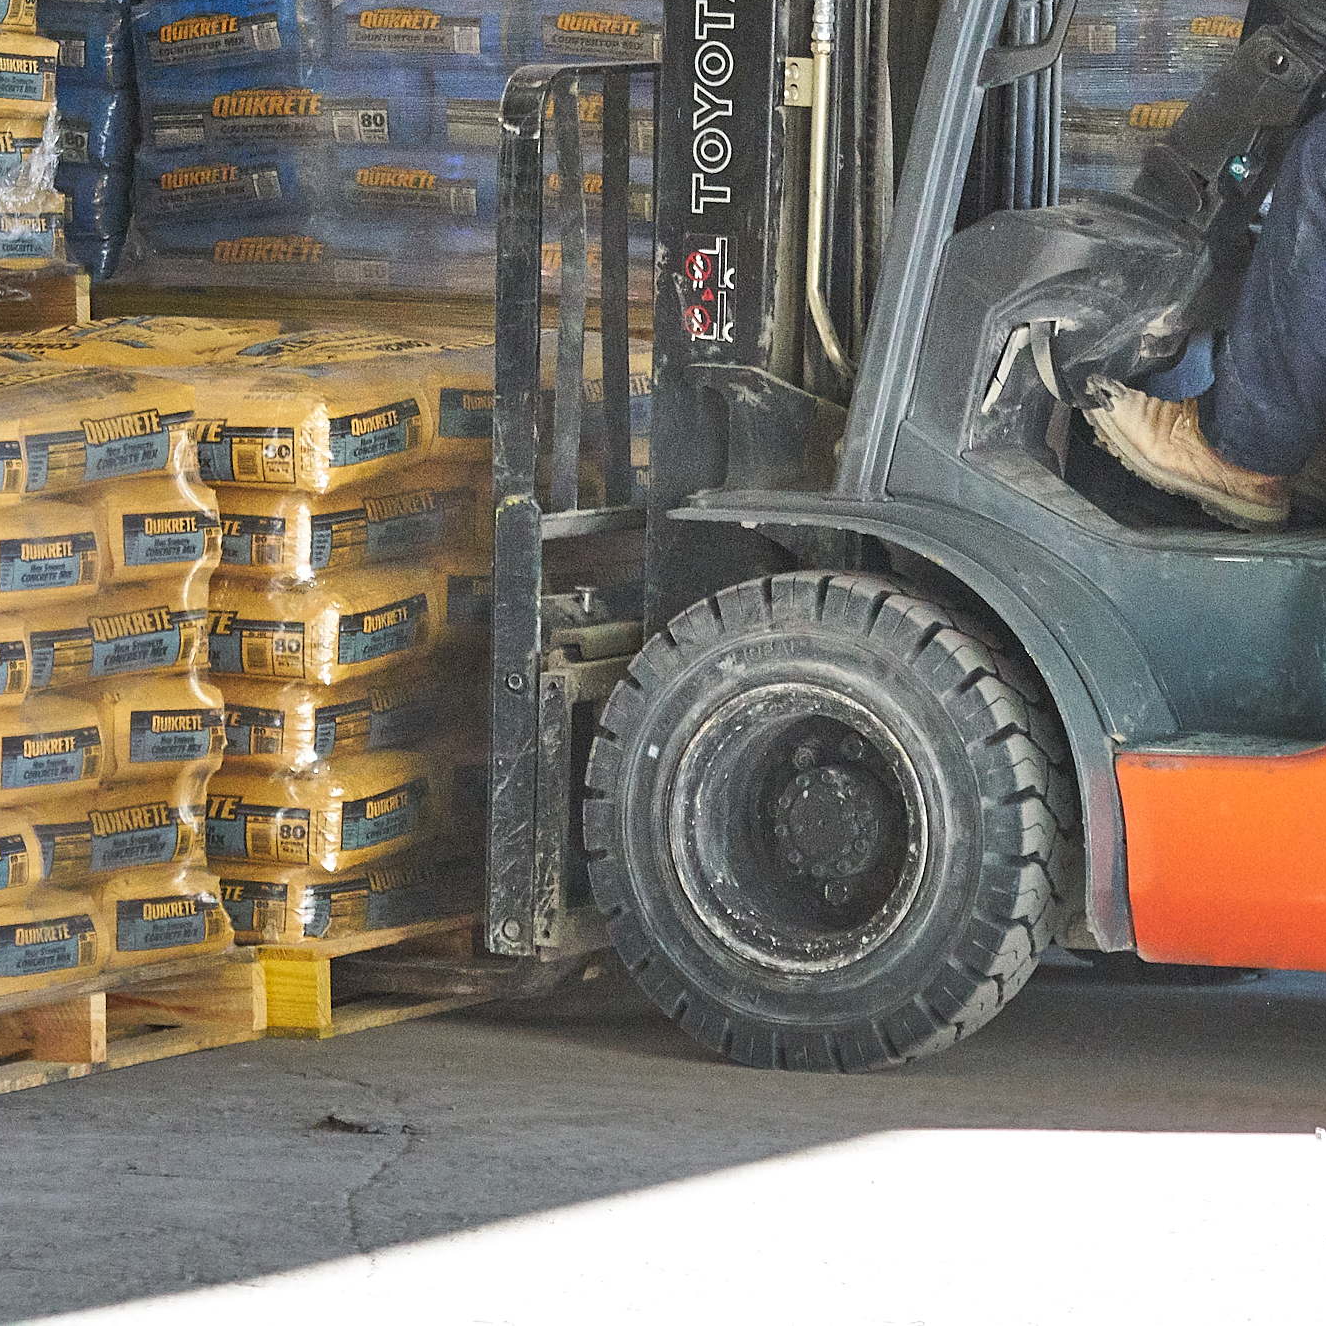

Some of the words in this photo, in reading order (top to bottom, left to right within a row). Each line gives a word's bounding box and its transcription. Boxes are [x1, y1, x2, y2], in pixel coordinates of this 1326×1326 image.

[83, 409, 162, 446] QUIKRETE
[91, 610, 172, 641] QUIKRETE
[277, 637, 302, 654] 80
[91, 802, 172, 835] QUIKRETE
[279, 824, 305, 840] 80
